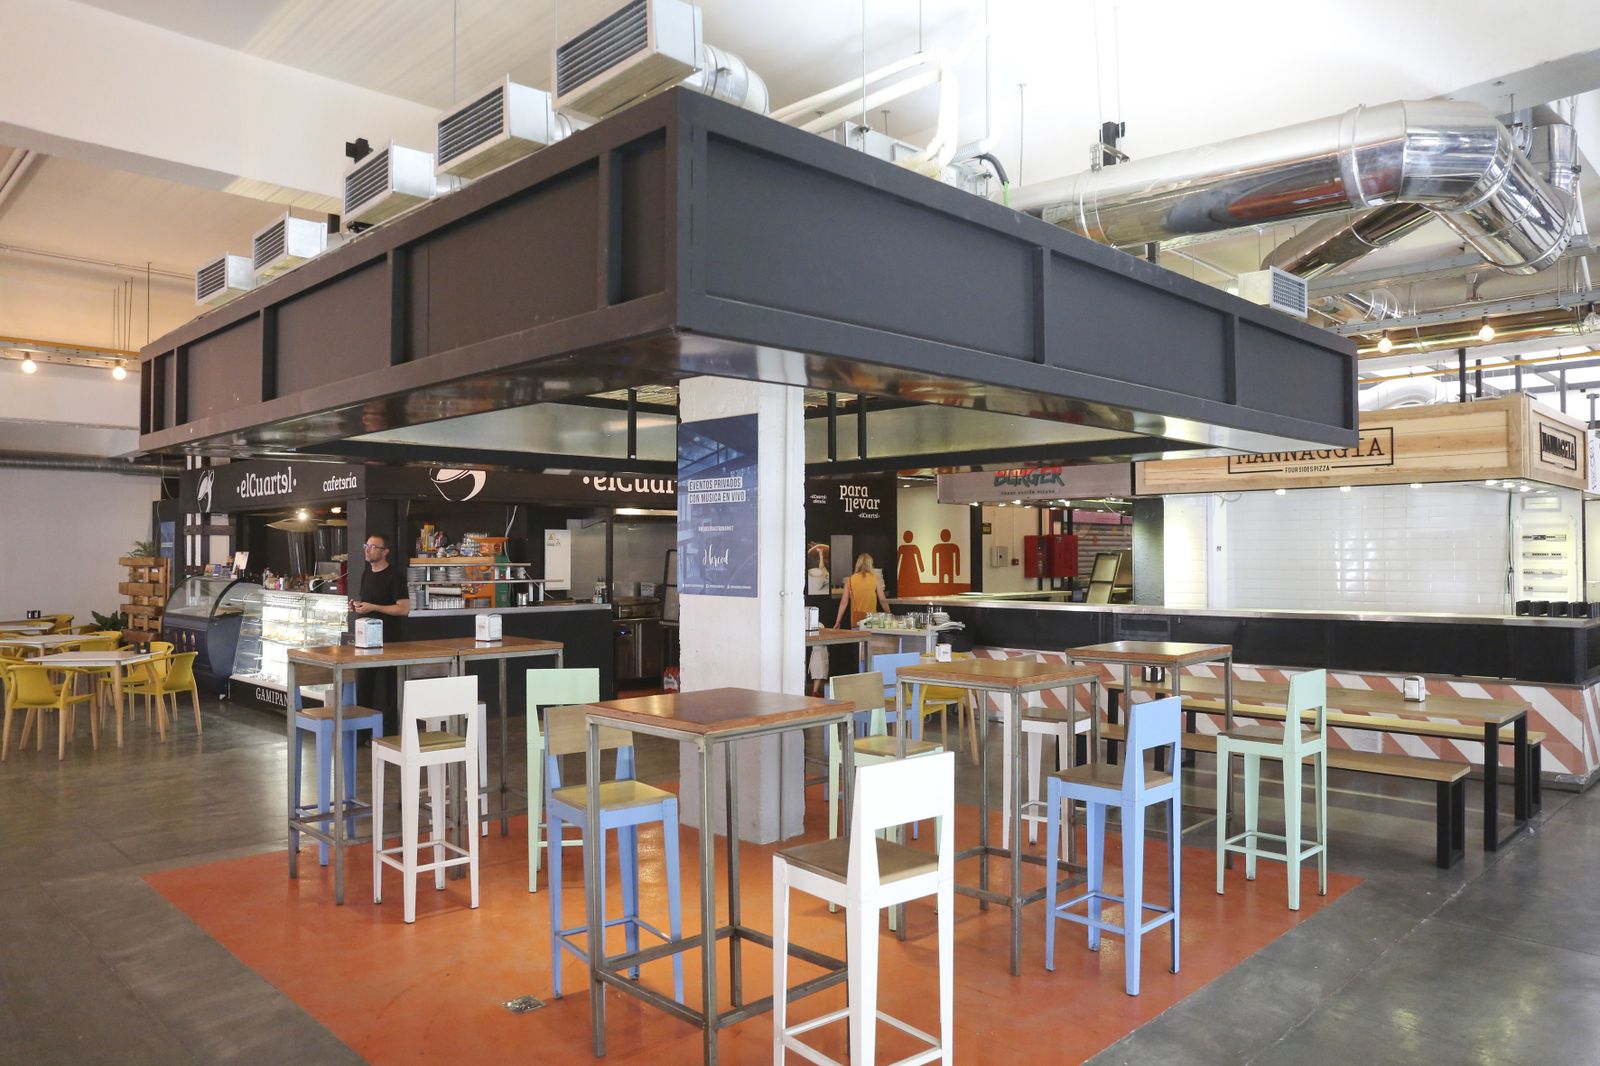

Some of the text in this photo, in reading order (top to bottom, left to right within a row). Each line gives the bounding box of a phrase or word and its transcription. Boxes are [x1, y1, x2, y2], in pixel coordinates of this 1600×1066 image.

[323, 472, 357, 492] cafetería
[690, 478, 741, 490] EVENTOS PRIVADOS
[690, 495, 700, 503] CON
[722, 492, 731, 501] EN
[732, 491, 744, 501] VIVO
[840, 485, 868, 499] para
[845, 498, 880, 512] llevar
